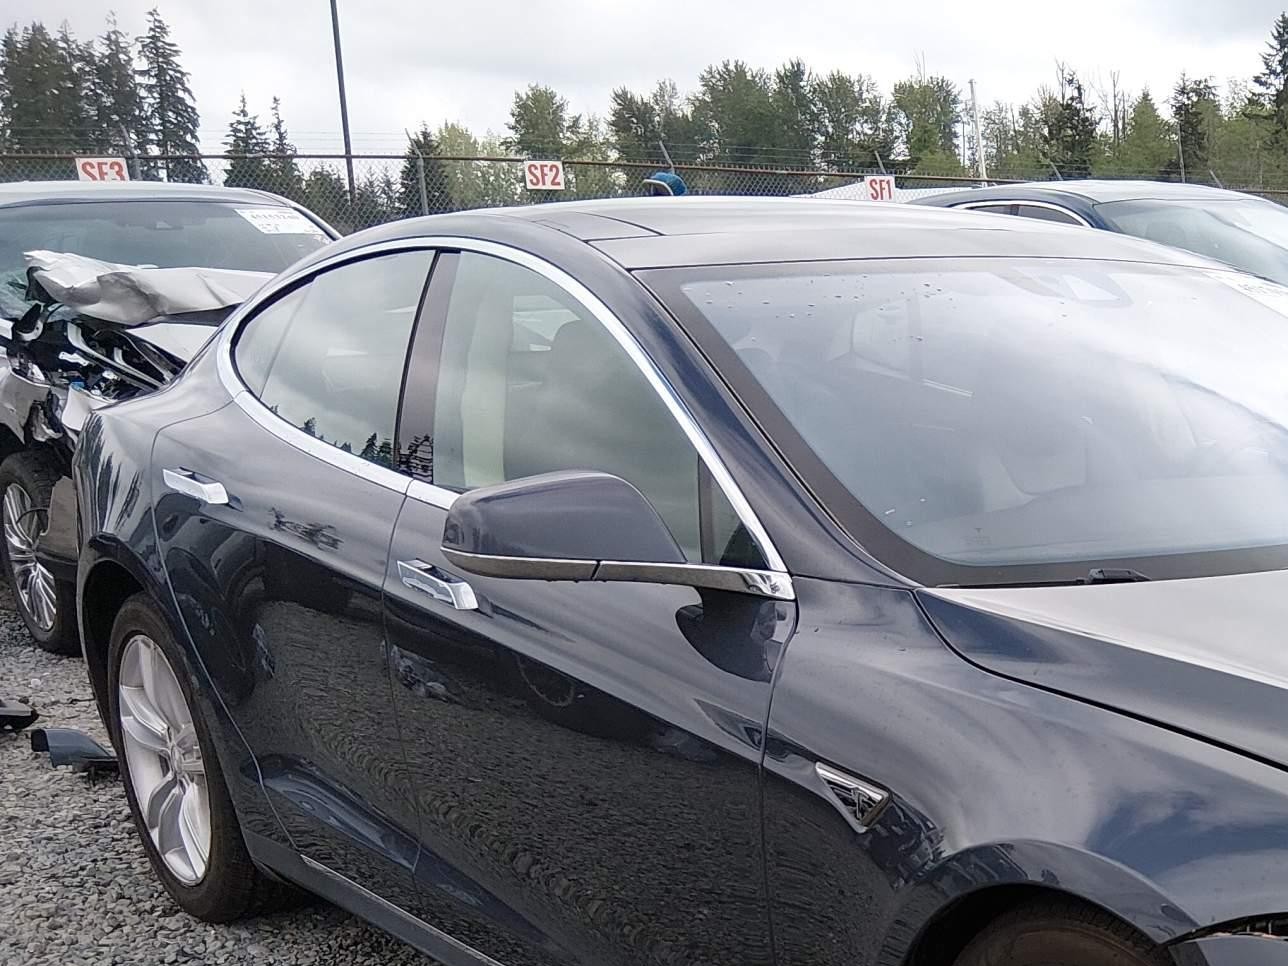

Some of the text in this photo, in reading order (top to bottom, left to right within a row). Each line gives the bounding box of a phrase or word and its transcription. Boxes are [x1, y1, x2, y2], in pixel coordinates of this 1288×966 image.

[81, 161, 126, 181] SF3
[527, 164, 561, 186] SF2
[869, 179, 893, 200] SF1
